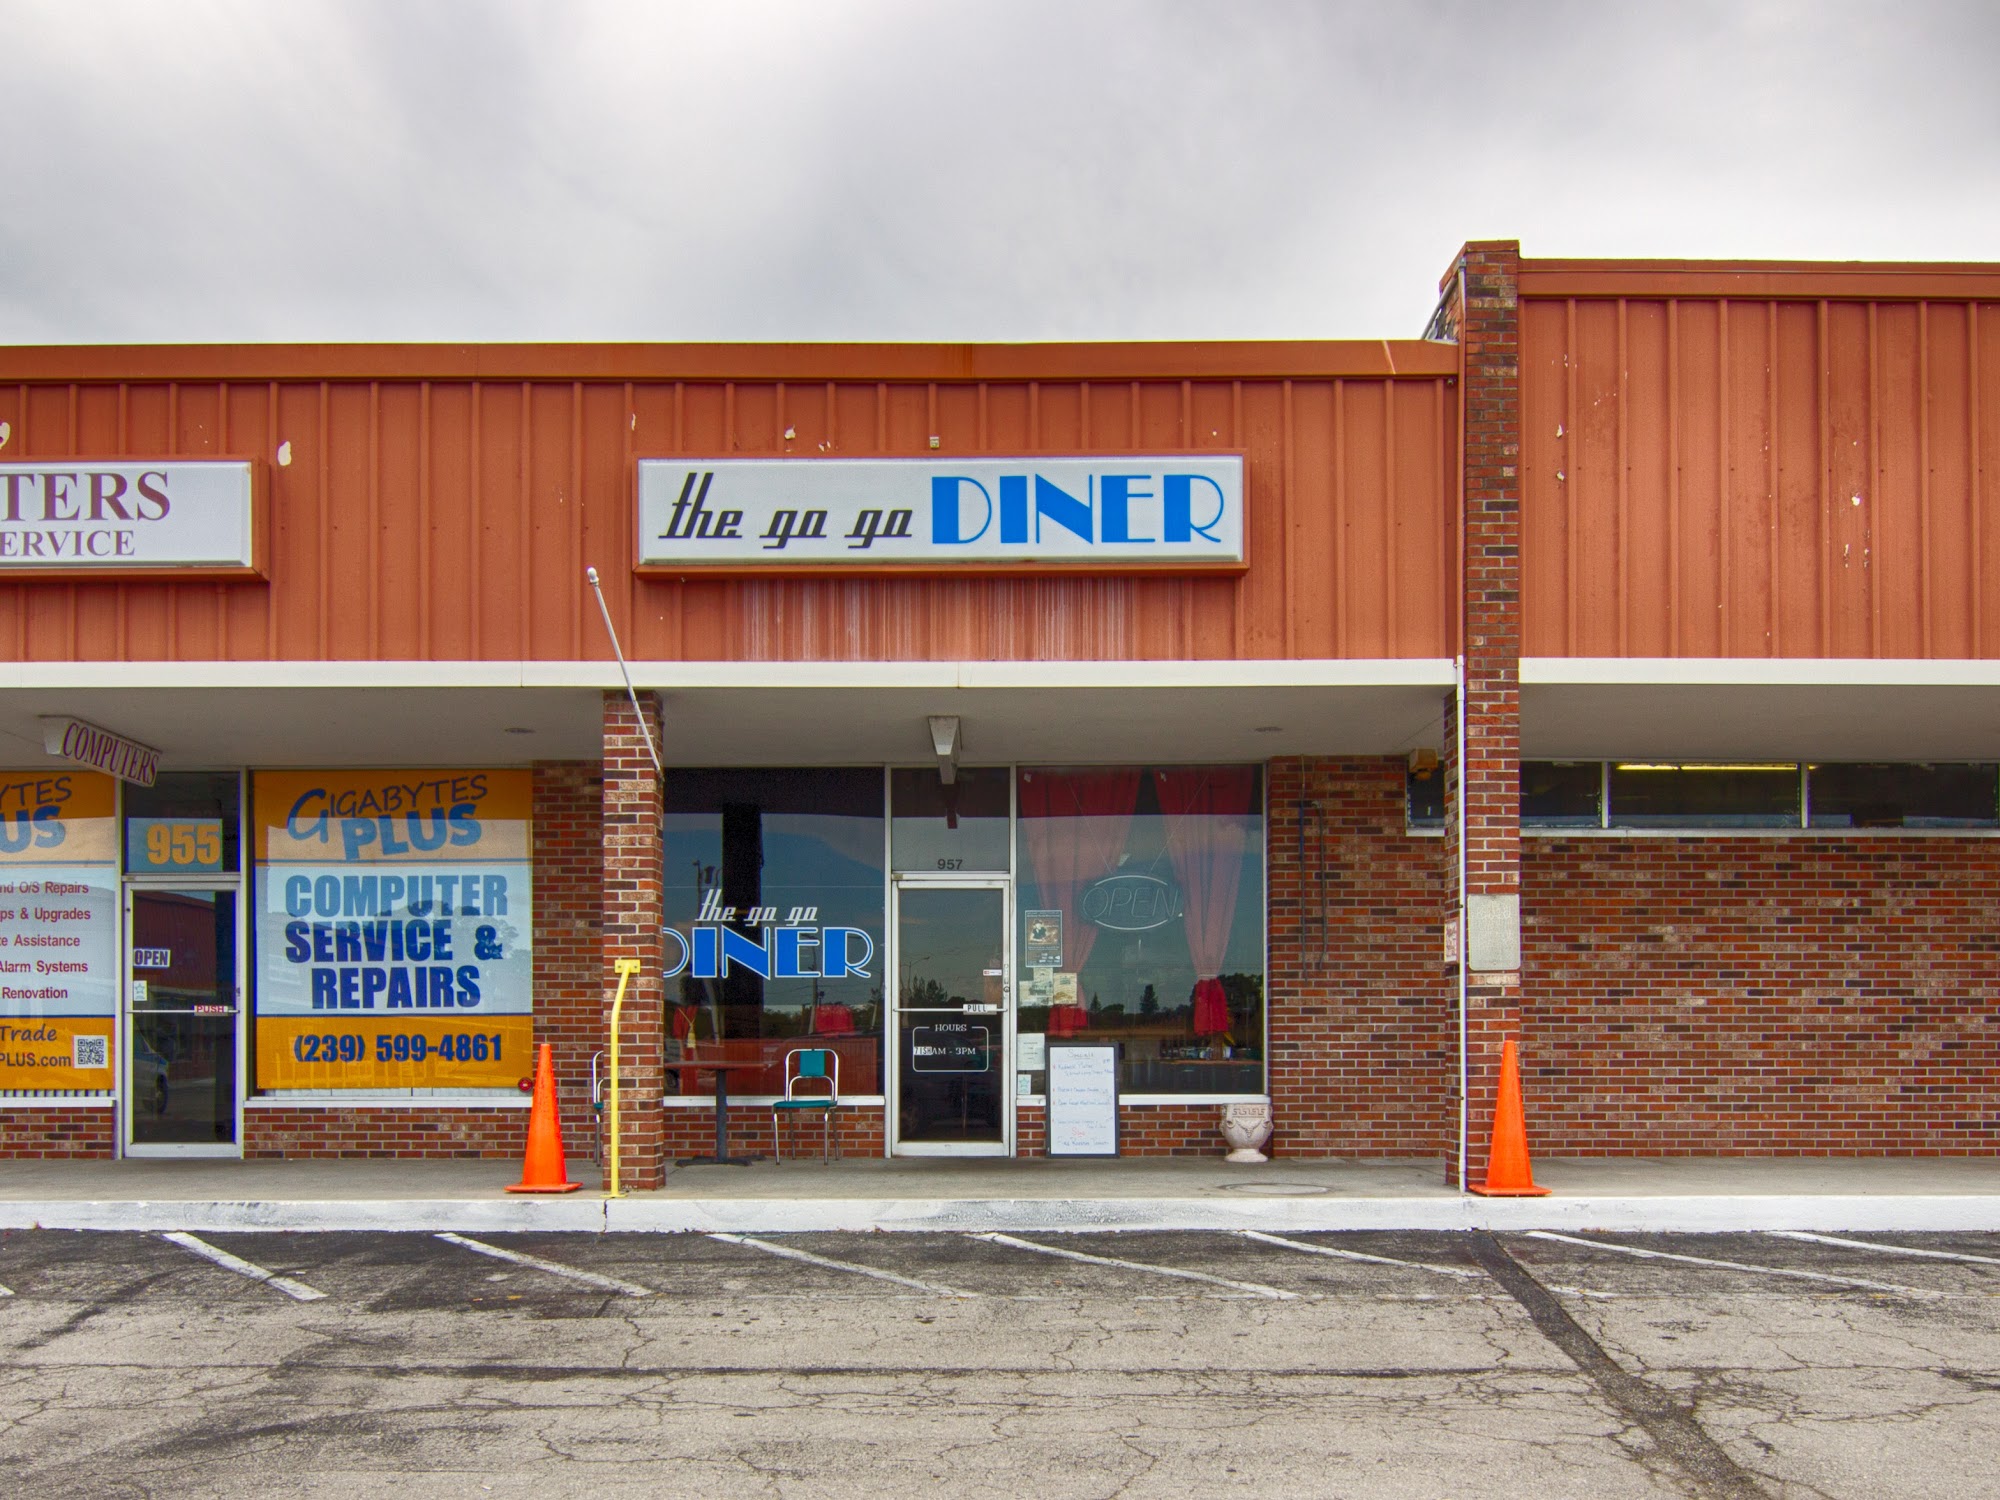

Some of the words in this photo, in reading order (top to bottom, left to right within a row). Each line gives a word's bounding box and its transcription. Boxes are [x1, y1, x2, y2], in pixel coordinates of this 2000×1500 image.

[0, 471, 170, 521] TERS
[658, 472, 743, 539] the
[759, 510, 828, 549] go
[844, 510, 912, 549] go
[931, 473, 1225, 545] DINER
[0, 530, 135, 556] ERVICE
[63, 722, 159, 785] COMPUTERS
[287, 774, 488, 844] GIGABYTES
[147, 823, 221, 865] 955
[341, 803, 482, 861] PLUS
[937, 858, 963, 870] 957
[45, 881, 89, 898] Repairs
[285, 874, 508, 918] COMPUTER
[1083, 887, 1179, 917] OPEN
[20, 907, 29, 920] &
[34, 907, 91, 923] Upgrades
[695, 888, 736, 921] the
[0, 934, 8, 946] e
[14, 934, 80, 946] Assistance
[285, 919, 453, 963] SERVICE
[474, 924, 503, 960] &
[36, 960, 88, 975] Systems
[134, 950, 168, 965] OPEN
[2, 986, 68, 999] Renovation
[311, 965, 481, 1009] REPAIRS
[967, 1004, 987, 1012] PULL
[0, 1023, 57, 1042] Trade
[935, 1024, 967, 1032] HOURS
[294, 1035, 365, 1063] (239)
[376, 1034, 502, 1062] 599-4861
[955, 1047, 976, 1055] 3PM
